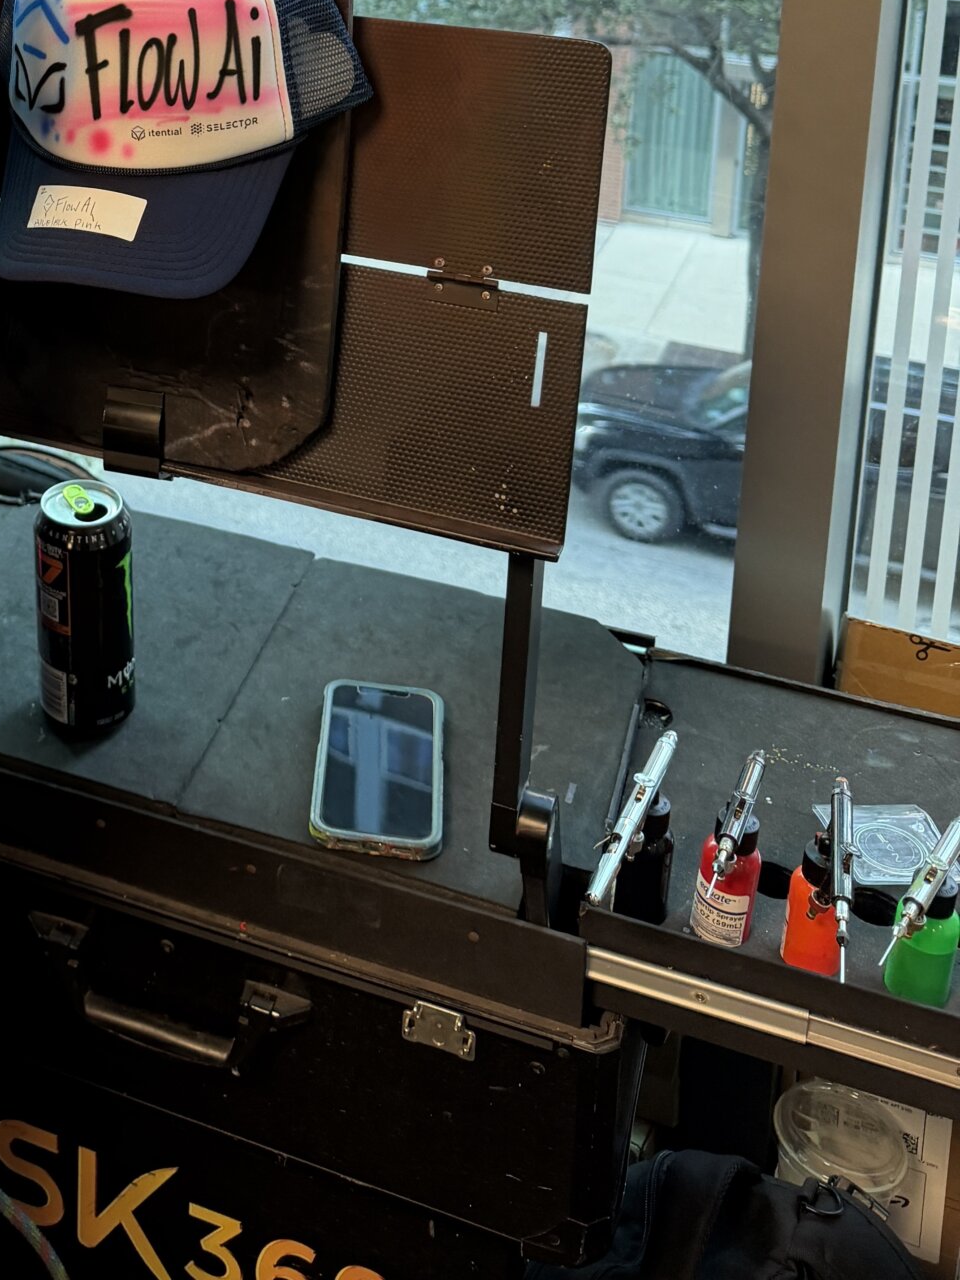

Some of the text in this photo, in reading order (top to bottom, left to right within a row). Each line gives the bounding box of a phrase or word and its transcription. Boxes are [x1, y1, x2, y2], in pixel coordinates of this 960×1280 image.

[148, 117, 259, 137] itential SELECTOR
[716, 912, 745, 922] Sprayer
